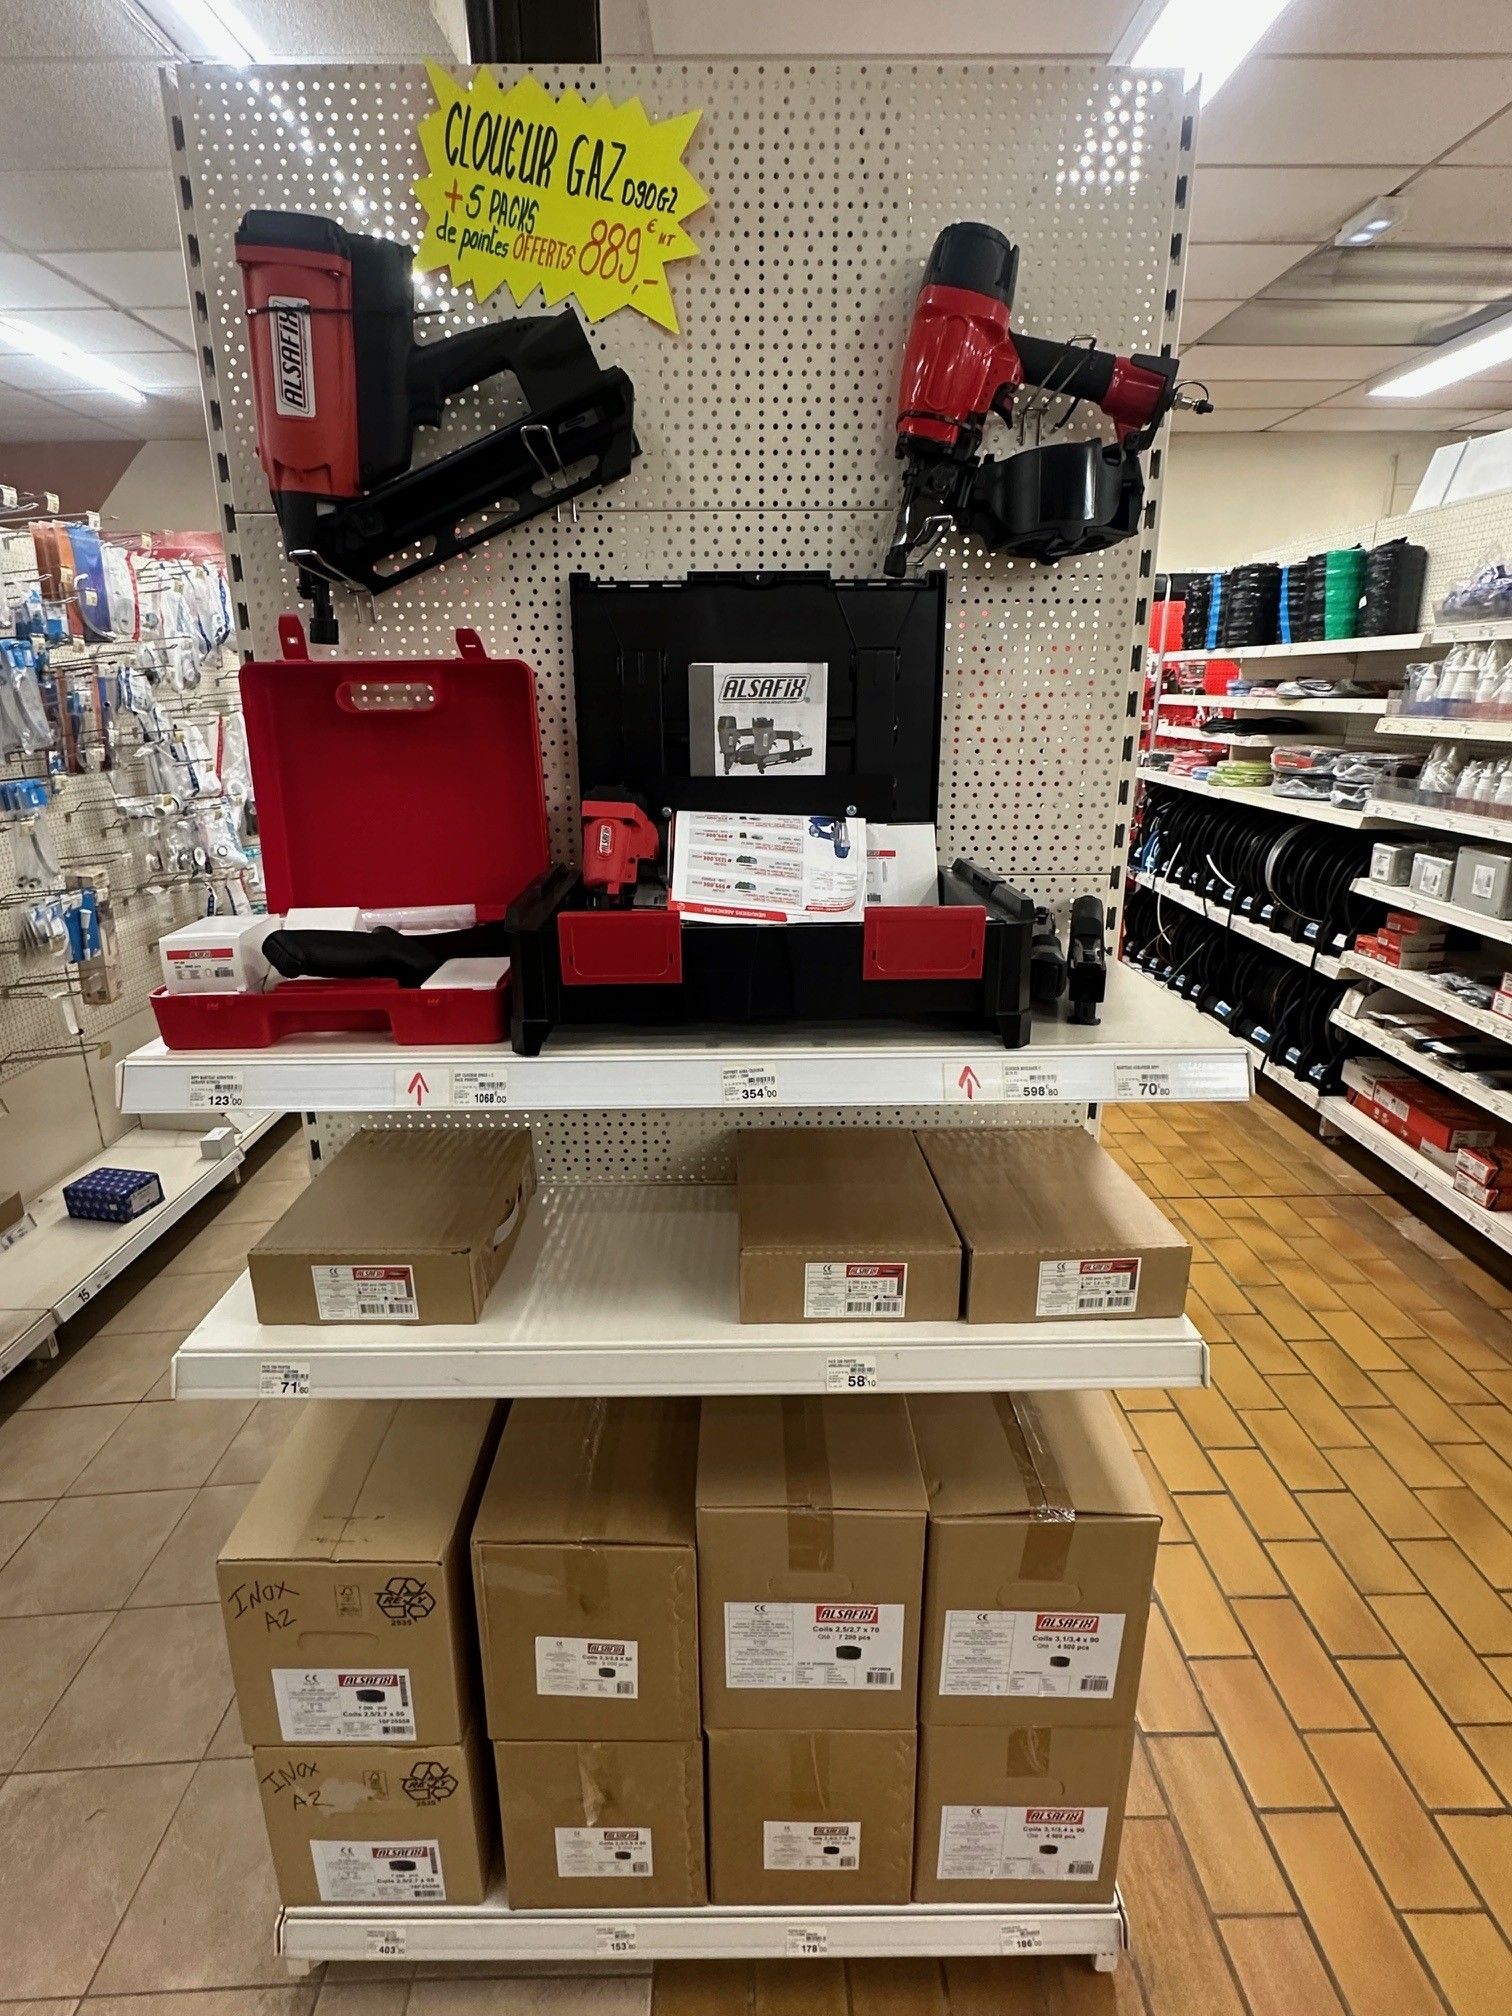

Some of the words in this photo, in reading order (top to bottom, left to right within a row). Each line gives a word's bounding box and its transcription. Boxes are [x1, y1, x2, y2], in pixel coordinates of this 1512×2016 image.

[445, 101, 558, 189] CLOUEUR
[566, 134, 627, 202] GAZ
[622, 178, 678, 214] D90G2
[466, 184, 485, 219] 5
[489, 186, 539, 234] PACKS
[436, 211, 456, 244] de
[458, 225, 509, 261] pointes
[513, 233, 576, 270] OFFERTS
[264, 1608, 298, 1632] A2
[820, 1608, 874, 1620] ALSAFIX
[1041, 1618, 1094, 1628] ALSAFIX
